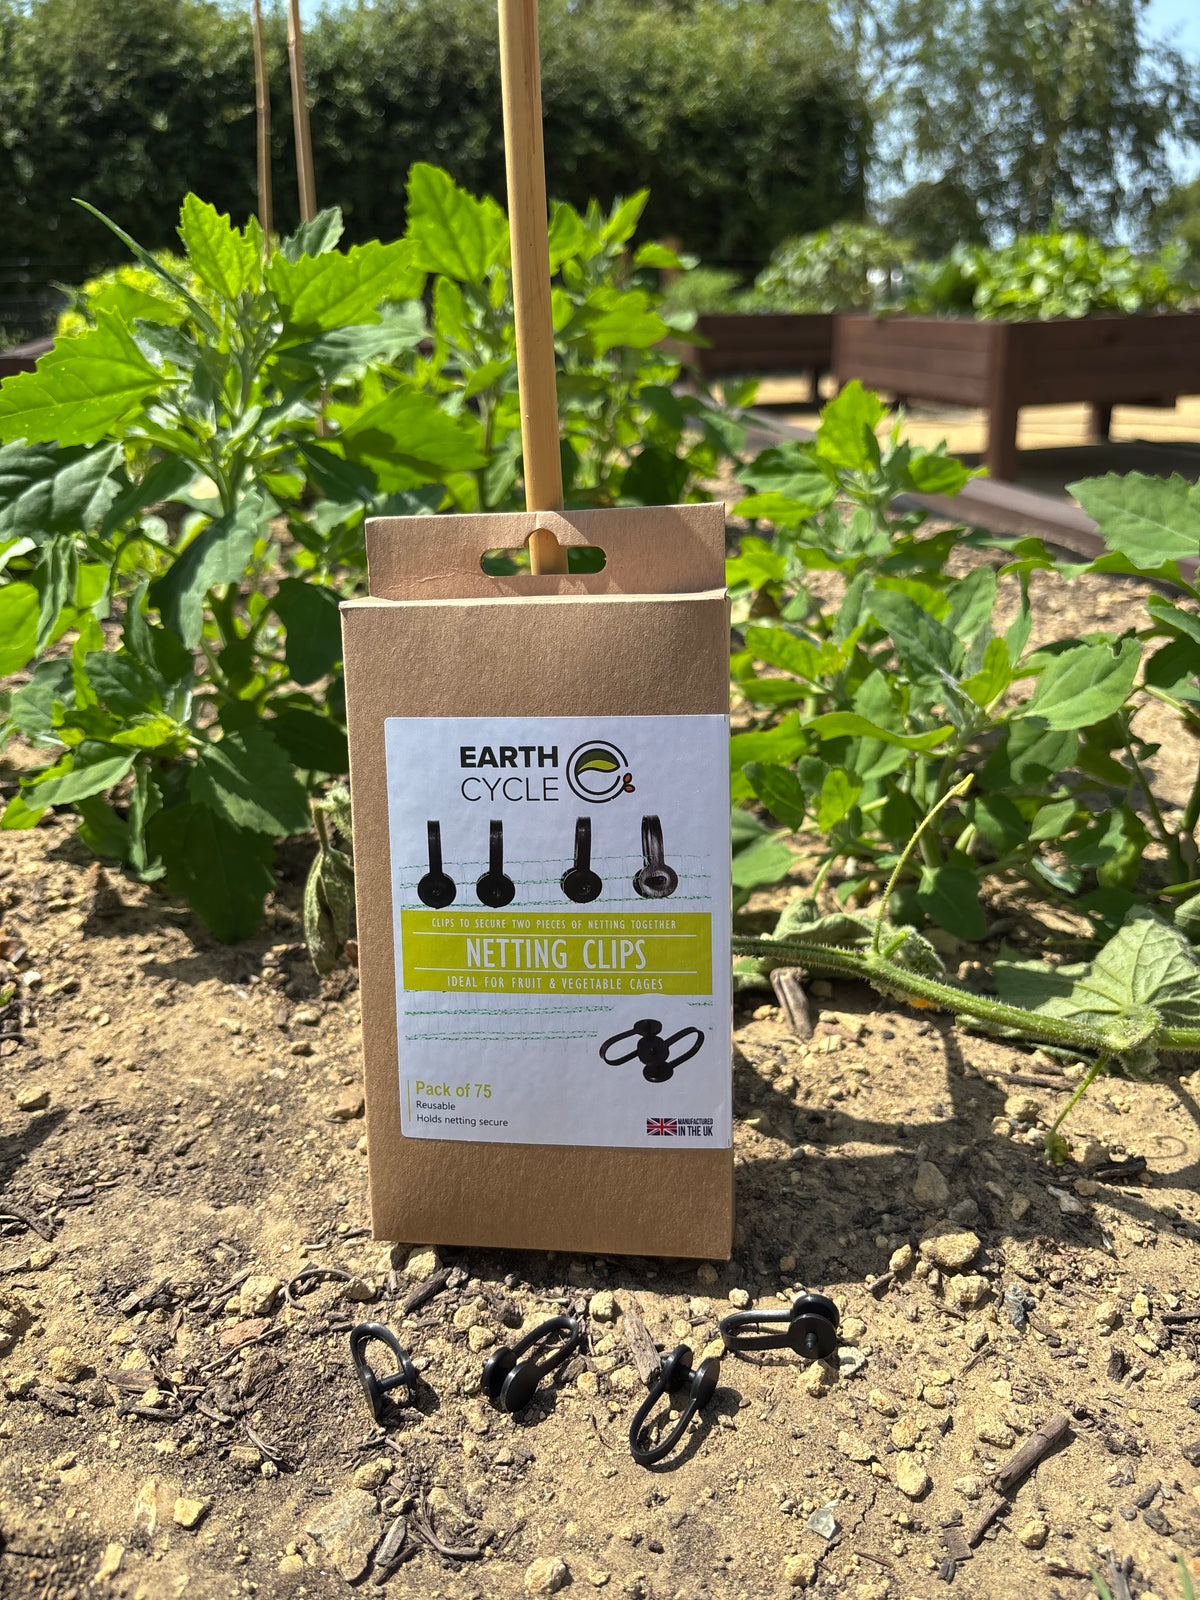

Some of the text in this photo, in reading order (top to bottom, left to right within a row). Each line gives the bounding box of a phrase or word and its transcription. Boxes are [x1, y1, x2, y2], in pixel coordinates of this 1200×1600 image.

[460, 746, 558, 768] EARTH
[461, 777, 559, 801] CYCLE
[432, 918, 677, 929] CLIPS TO SECURE TWO PIECES OF NETTING TOGETHER
[466, 938, 646, 970] NETTING CLIPS
[447, 976, 663, 990] IDEAL FOR FRUIT & VEGETABLE CAGES
[416, 1081, 492, 1098] Pack of 75
[416, 1101, 455, 1110] Reusable
[417, 1114, 508, 1127] Holds netting secure
[678, 1126, 713, 1136] IN THE UK
